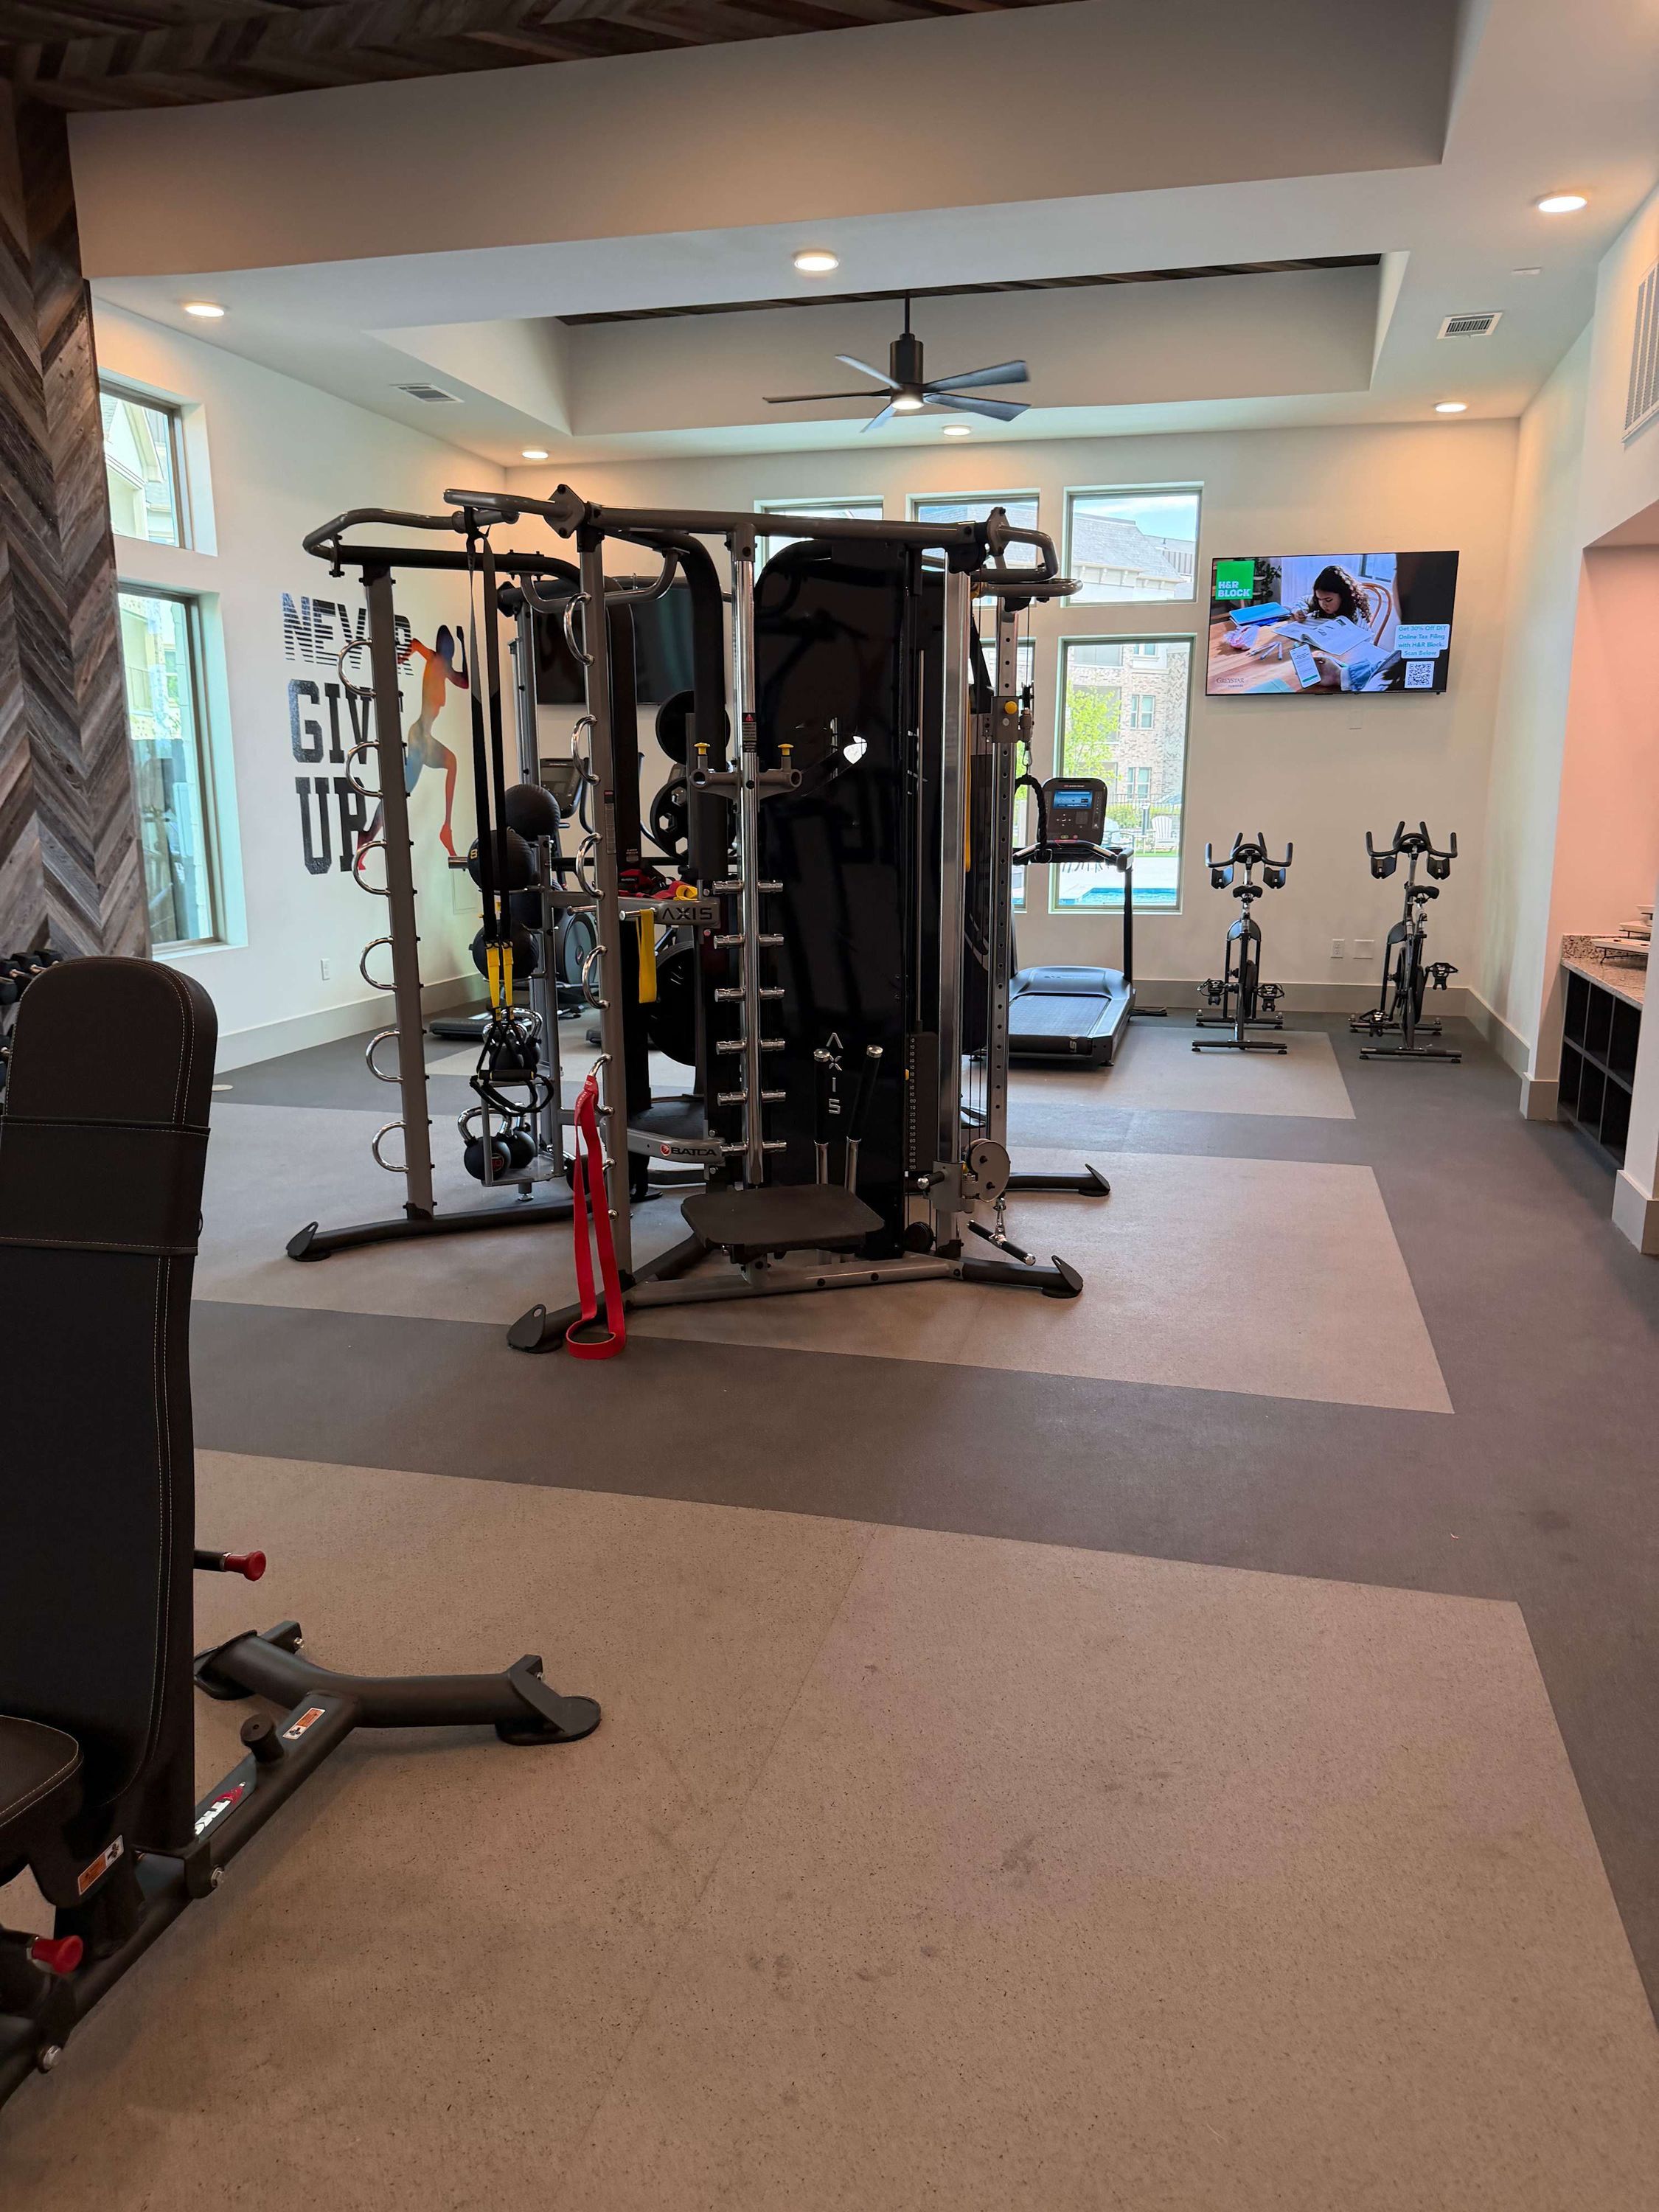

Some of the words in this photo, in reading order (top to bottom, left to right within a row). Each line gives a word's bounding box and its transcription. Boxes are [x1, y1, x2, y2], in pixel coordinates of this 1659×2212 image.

[1218, 589, 1252, 597] BLOCK
[281, 592, 414, 676] NEVR
[295, 776, 369, 874] UP
[662, 908, 712, 920] AXIS
[826, 1032, 844, 1115] AXIS
[671, 1147, 717, 1156] BATCA
